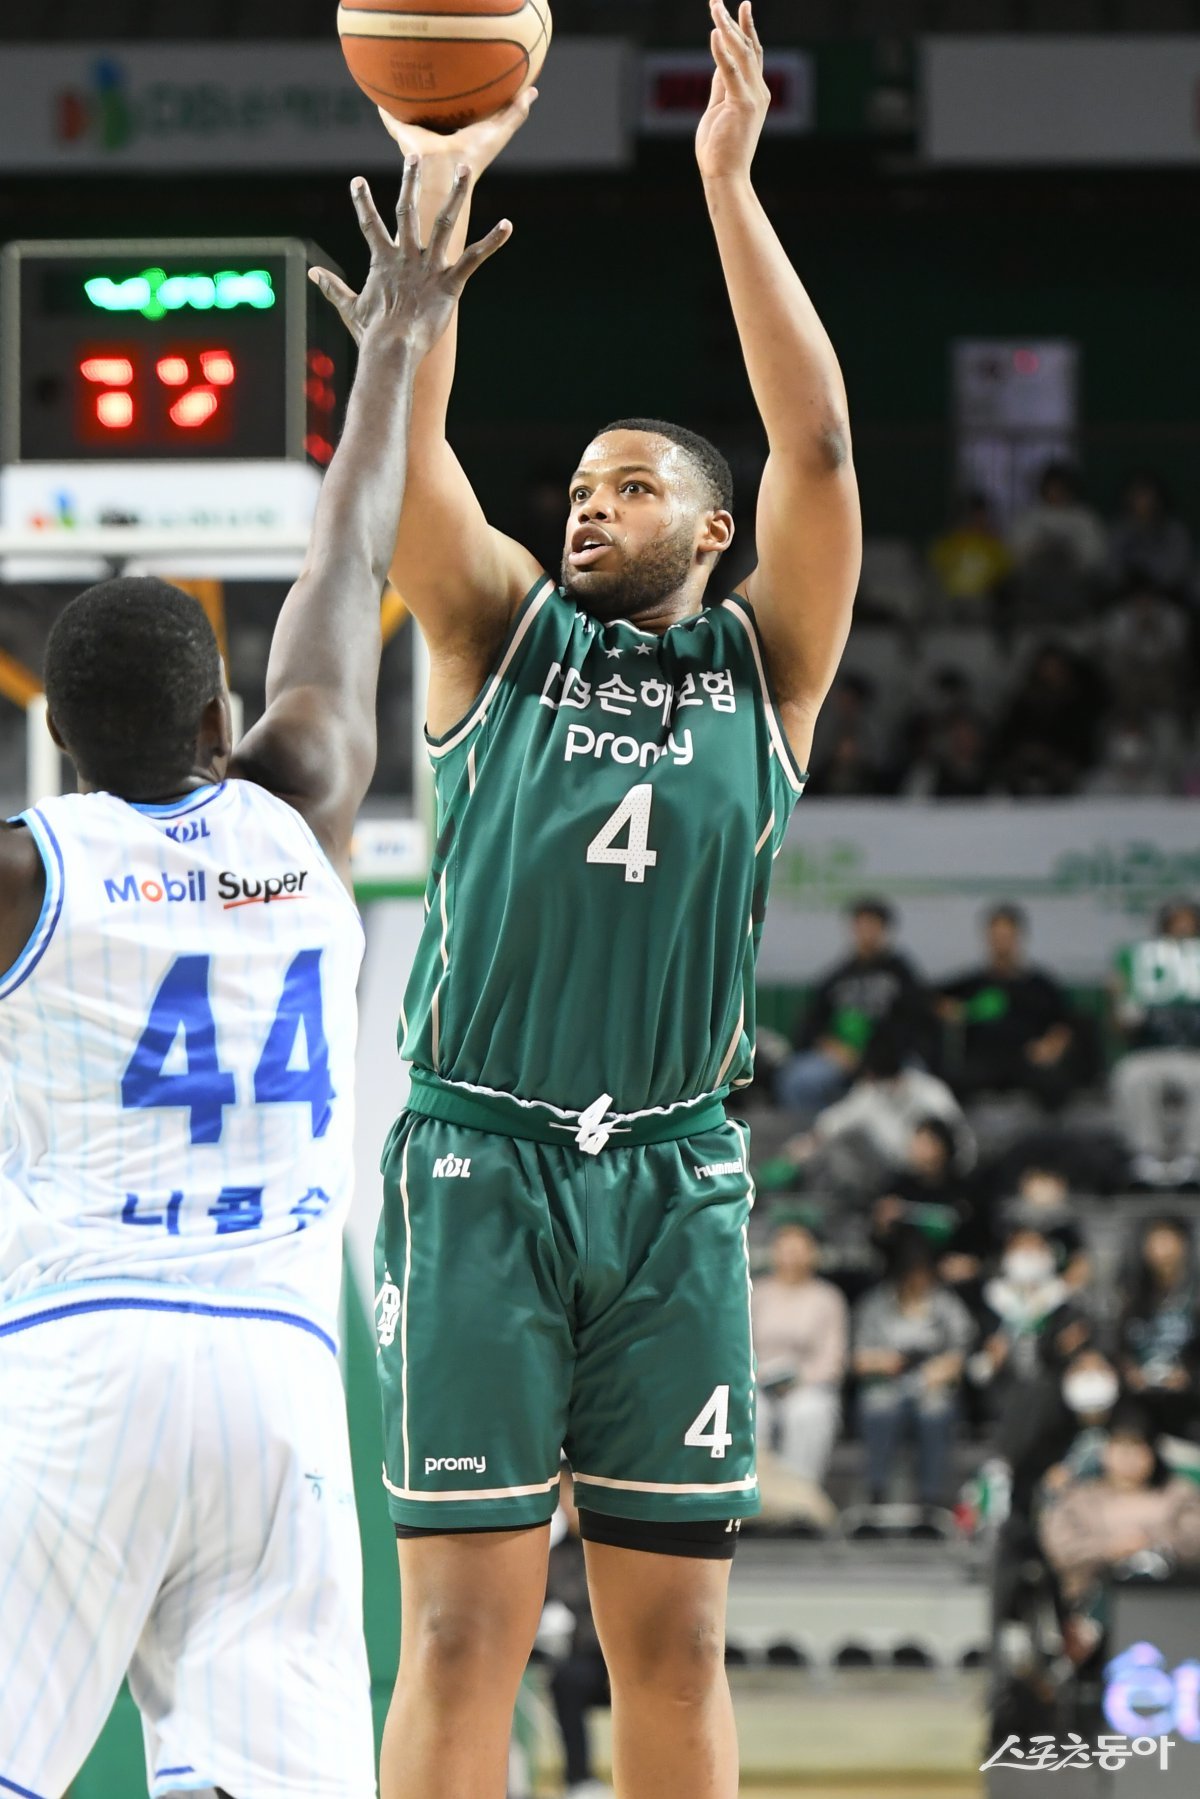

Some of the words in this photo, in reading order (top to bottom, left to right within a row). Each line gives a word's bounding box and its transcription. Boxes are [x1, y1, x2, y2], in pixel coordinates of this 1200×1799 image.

[586, 783, 657, 883] 4
[103, 870, 206, 903] Mobil
[217, 869, 308, 904] Super
[121, 948, 337, 1145] 44
[432, 1152, 472, 1178] KBL
[693, 1157, 744, 1180] hummel
[684, 1384, 733, 1459] 4
[424, 1456, 487, 1475] promy
